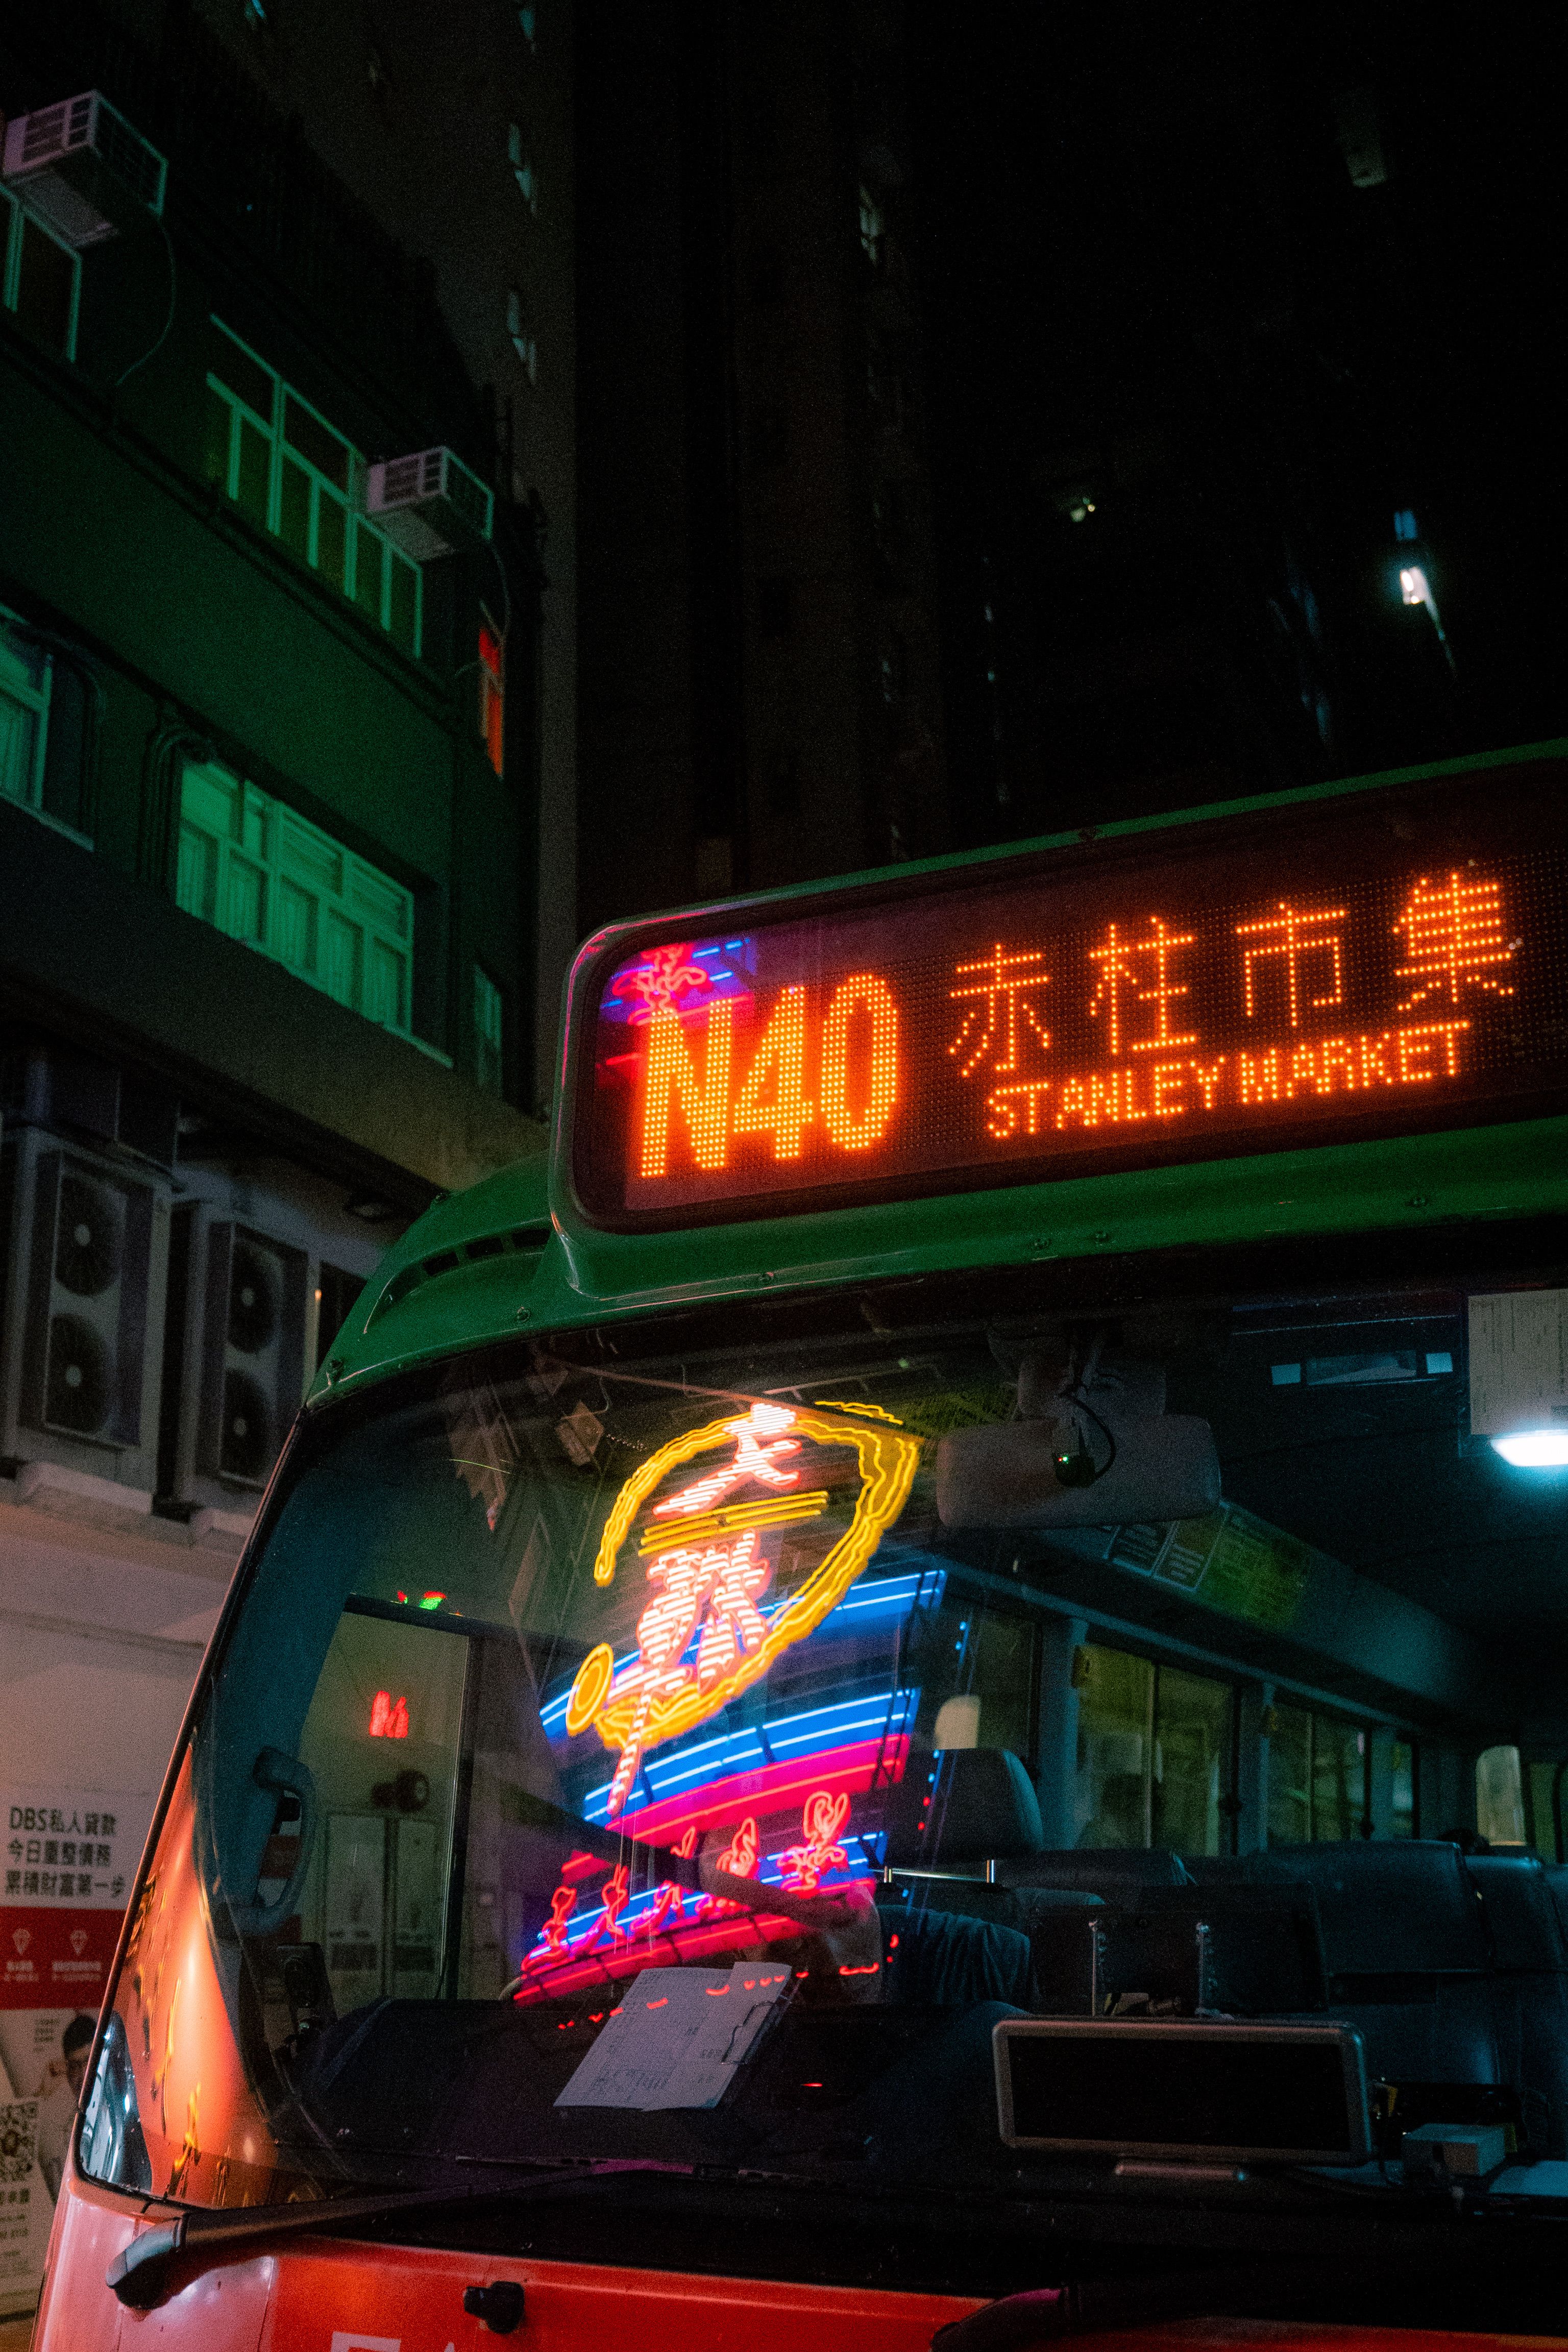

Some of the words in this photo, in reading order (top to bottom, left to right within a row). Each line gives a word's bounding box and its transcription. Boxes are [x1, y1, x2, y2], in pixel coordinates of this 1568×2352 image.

[640, 972, 898, 1178] N40
[948, 872, 1515, 1077] 赤柱市集
[986, 1056, 1226, 1138] STANLEY
[1240, 1019, 1471, 1105] MARKET
